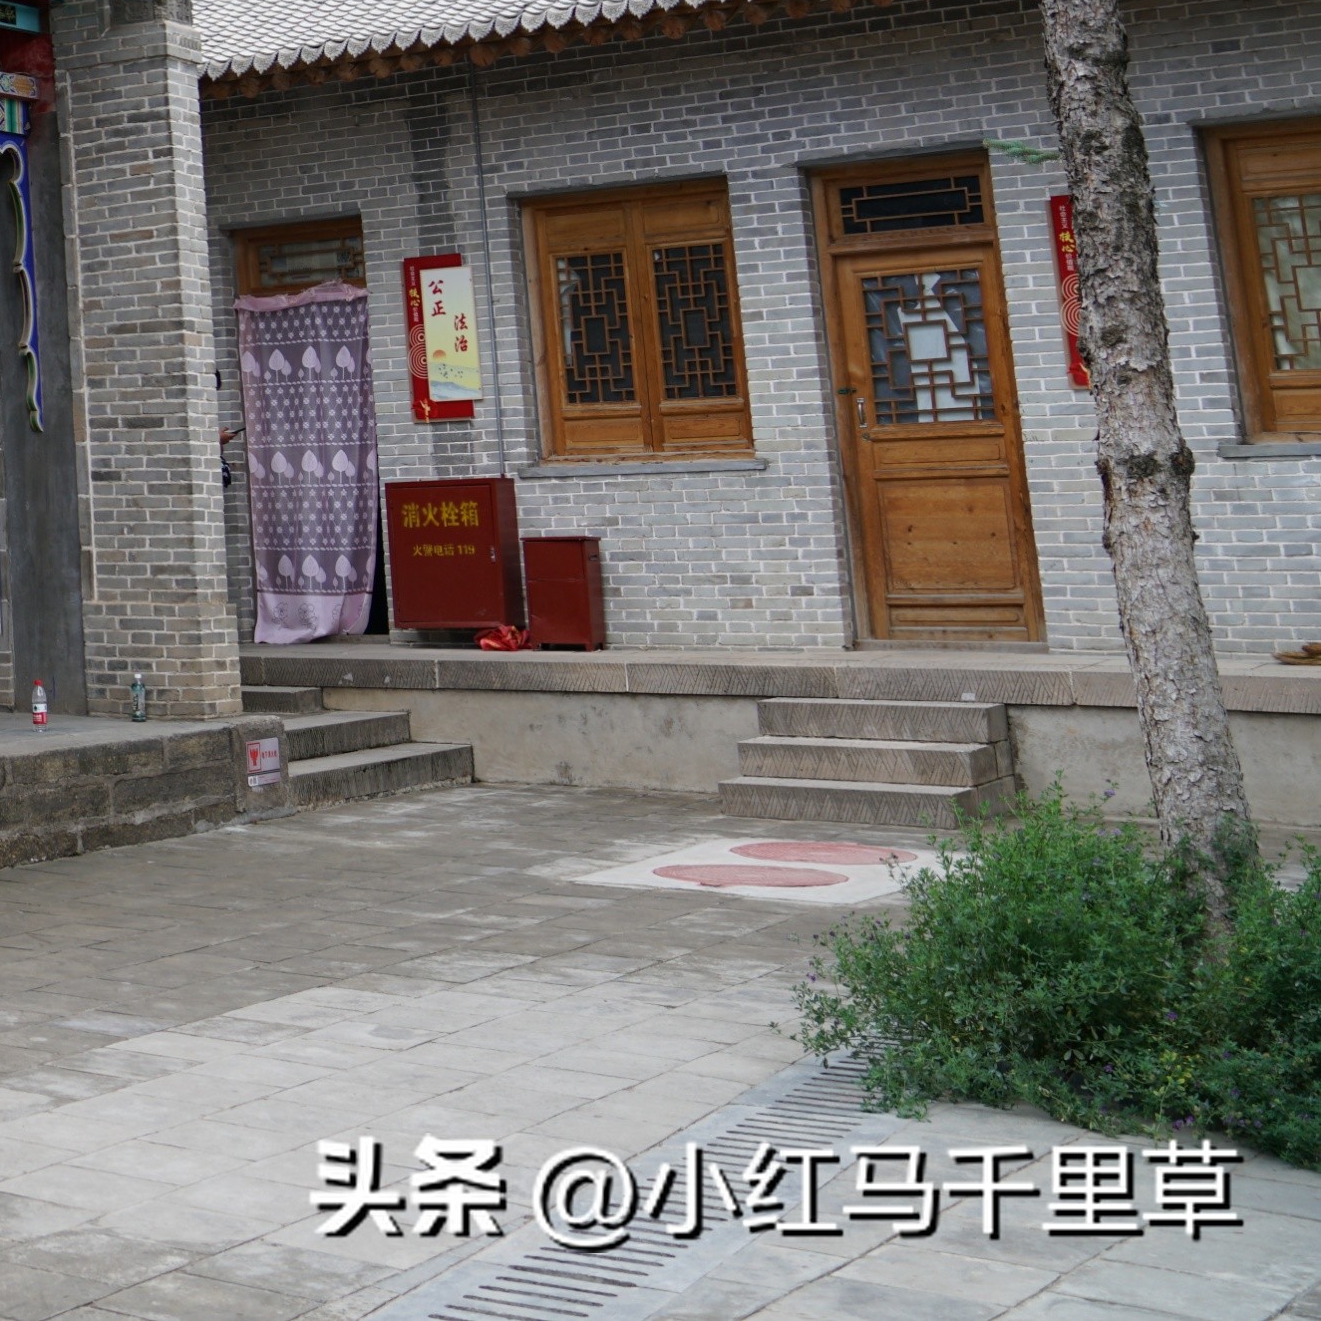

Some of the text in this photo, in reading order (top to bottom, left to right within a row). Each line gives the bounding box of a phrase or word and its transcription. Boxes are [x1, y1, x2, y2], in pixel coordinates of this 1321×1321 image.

[428, 279, 447, 317] 公正
[453, 312, 468, 353] 法治
[401, 501, 480, 528] 消火栓箱
[412, 544, 476, 557] 火警电话 119
